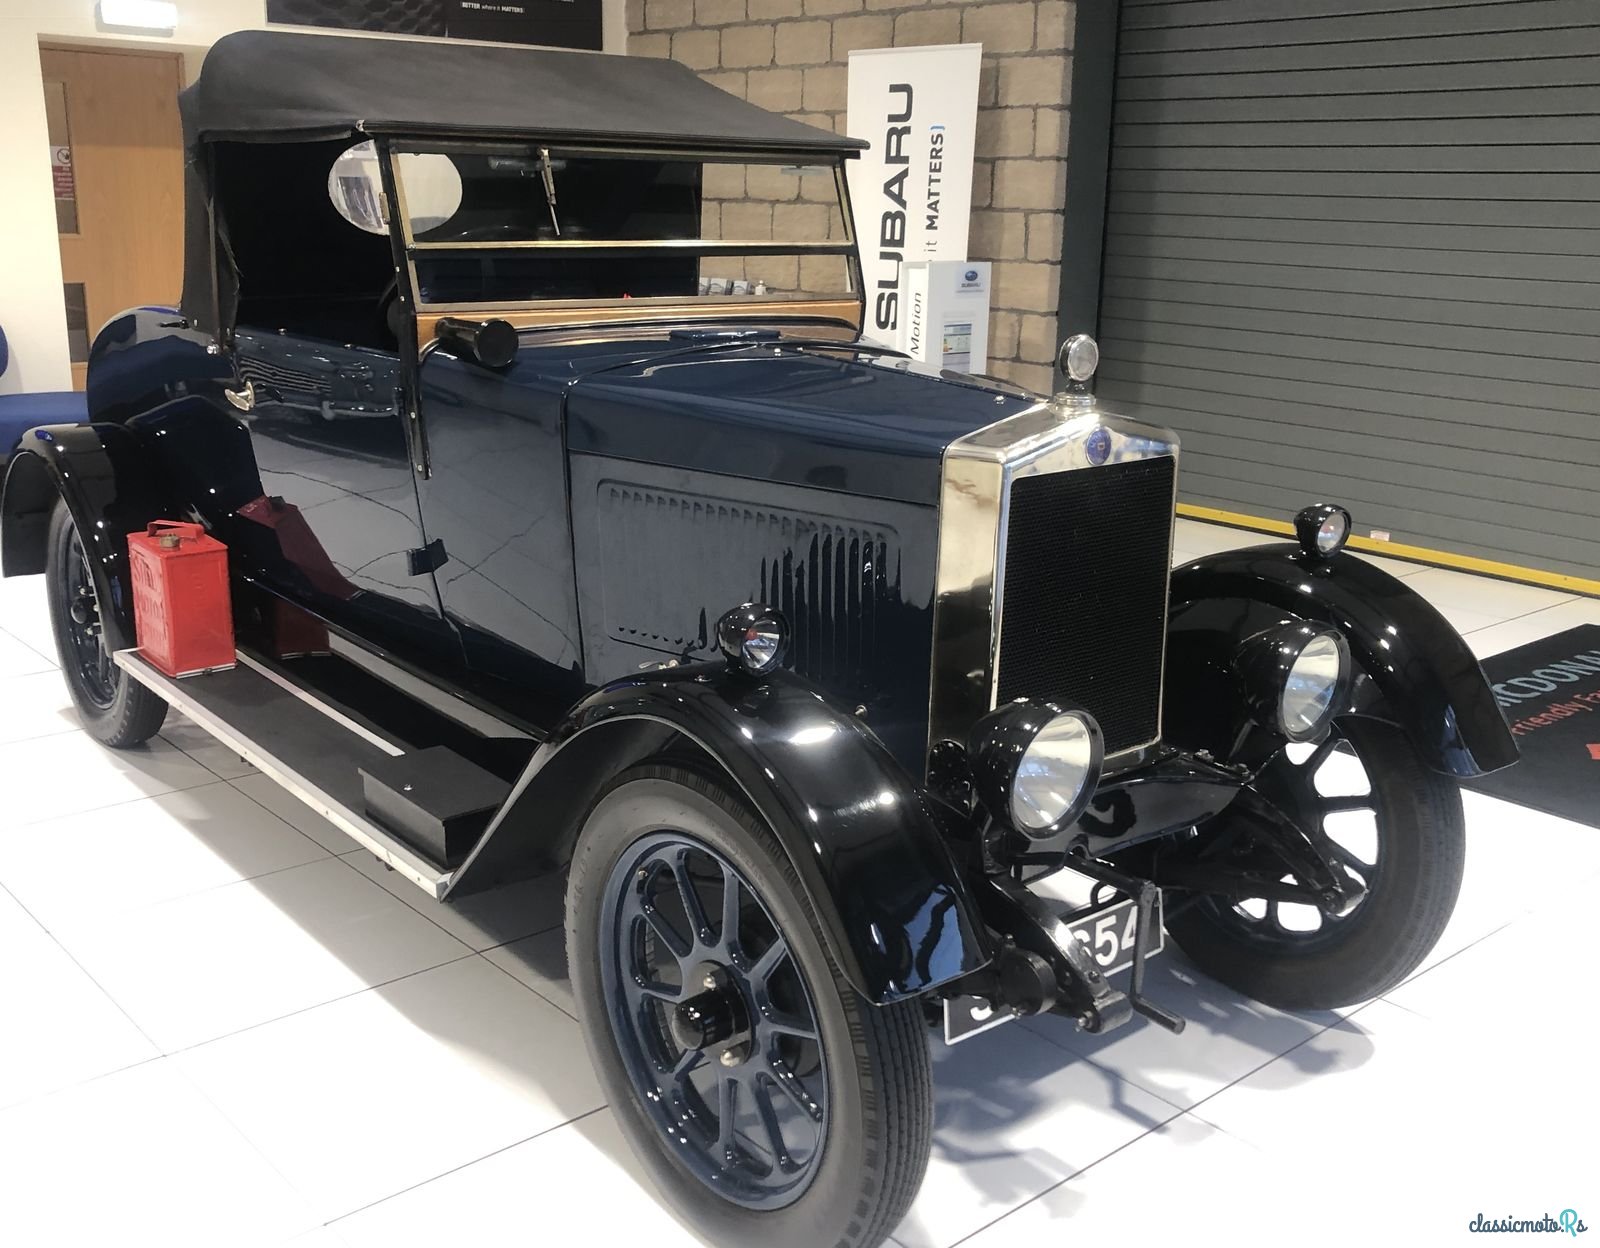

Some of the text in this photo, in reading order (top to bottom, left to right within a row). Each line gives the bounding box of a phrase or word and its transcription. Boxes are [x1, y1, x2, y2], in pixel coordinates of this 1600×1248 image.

[875, 83, 914, 331] SUBARU
[923, 240, 938, 253] it
[910, 292, 922, 355] Motion
